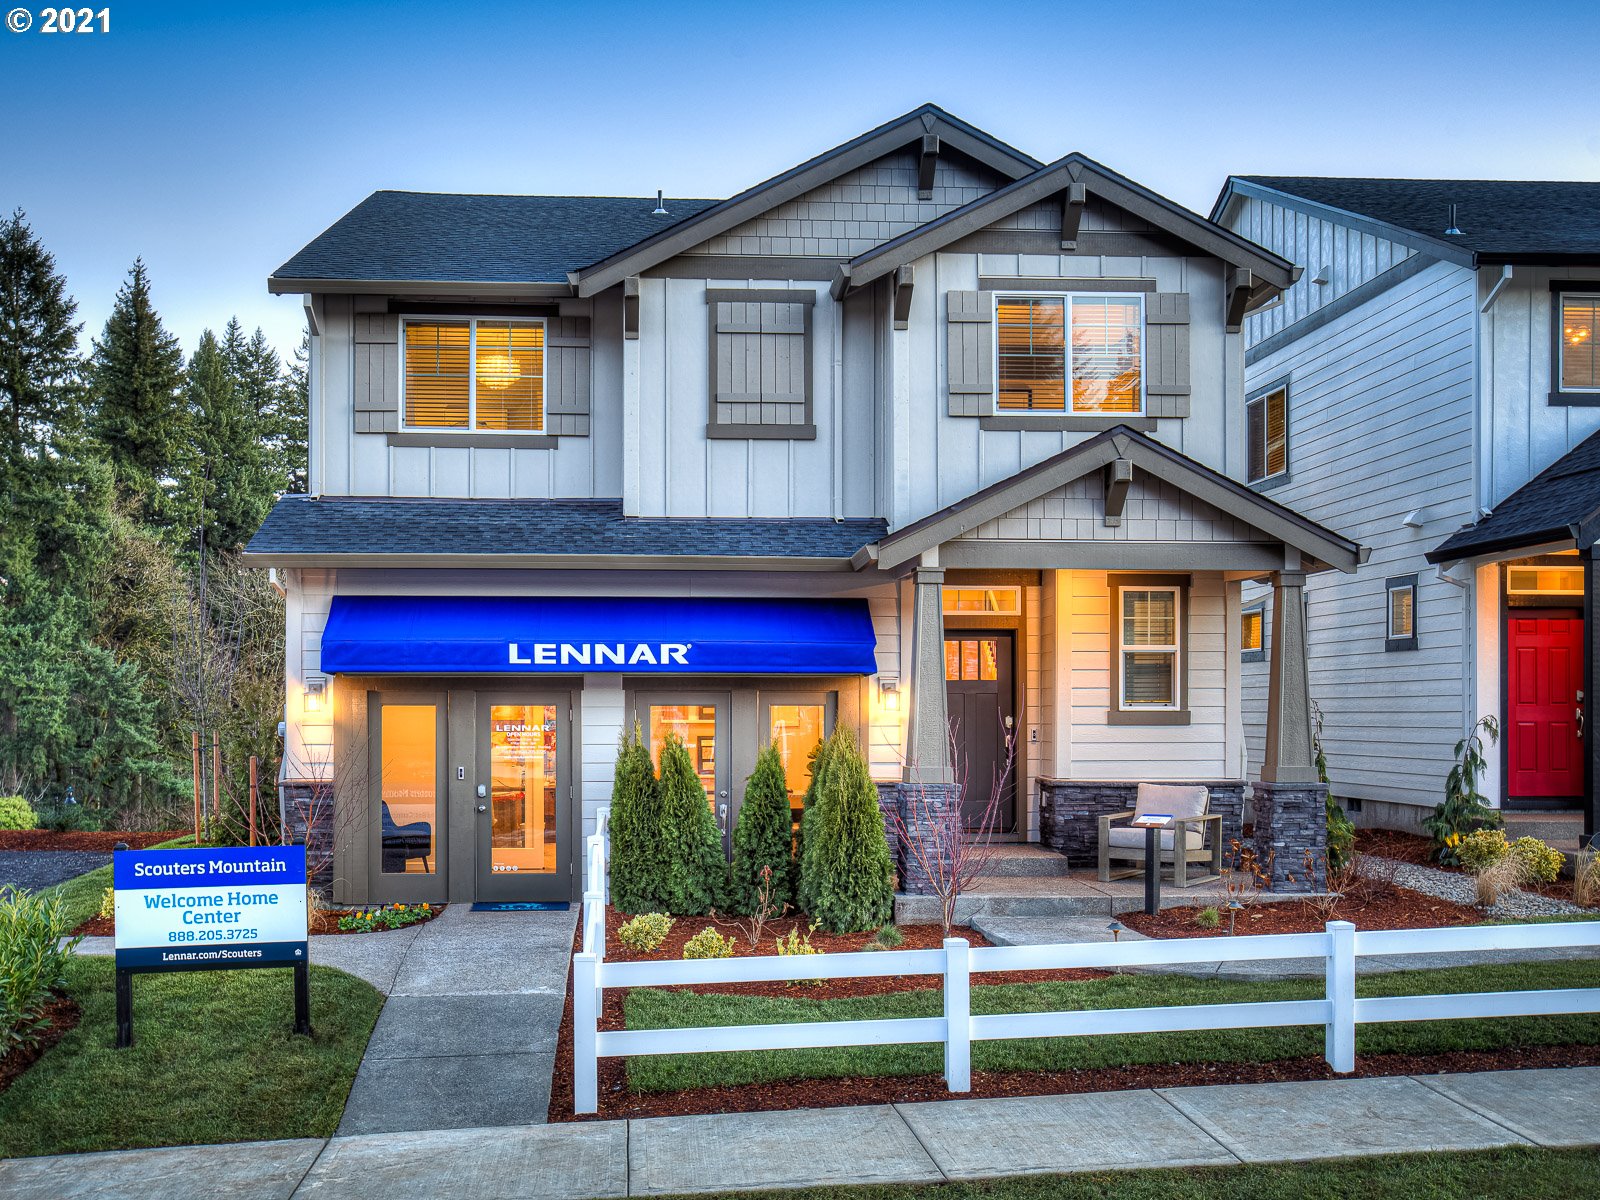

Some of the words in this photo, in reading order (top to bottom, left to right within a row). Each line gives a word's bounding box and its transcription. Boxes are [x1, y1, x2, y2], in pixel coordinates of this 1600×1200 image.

[134, 862, 206, 877] Scouters
[208, 858, 287, 874] Mountain
[143, 893, 224, 909] Welcome
[227, 891, 279, 906] Home
[182, 910, 242, 925] Center
[168, 928, 258, 942] 888.205.3725
[162, 948, 262, 961] Lennar.com/Scouters
